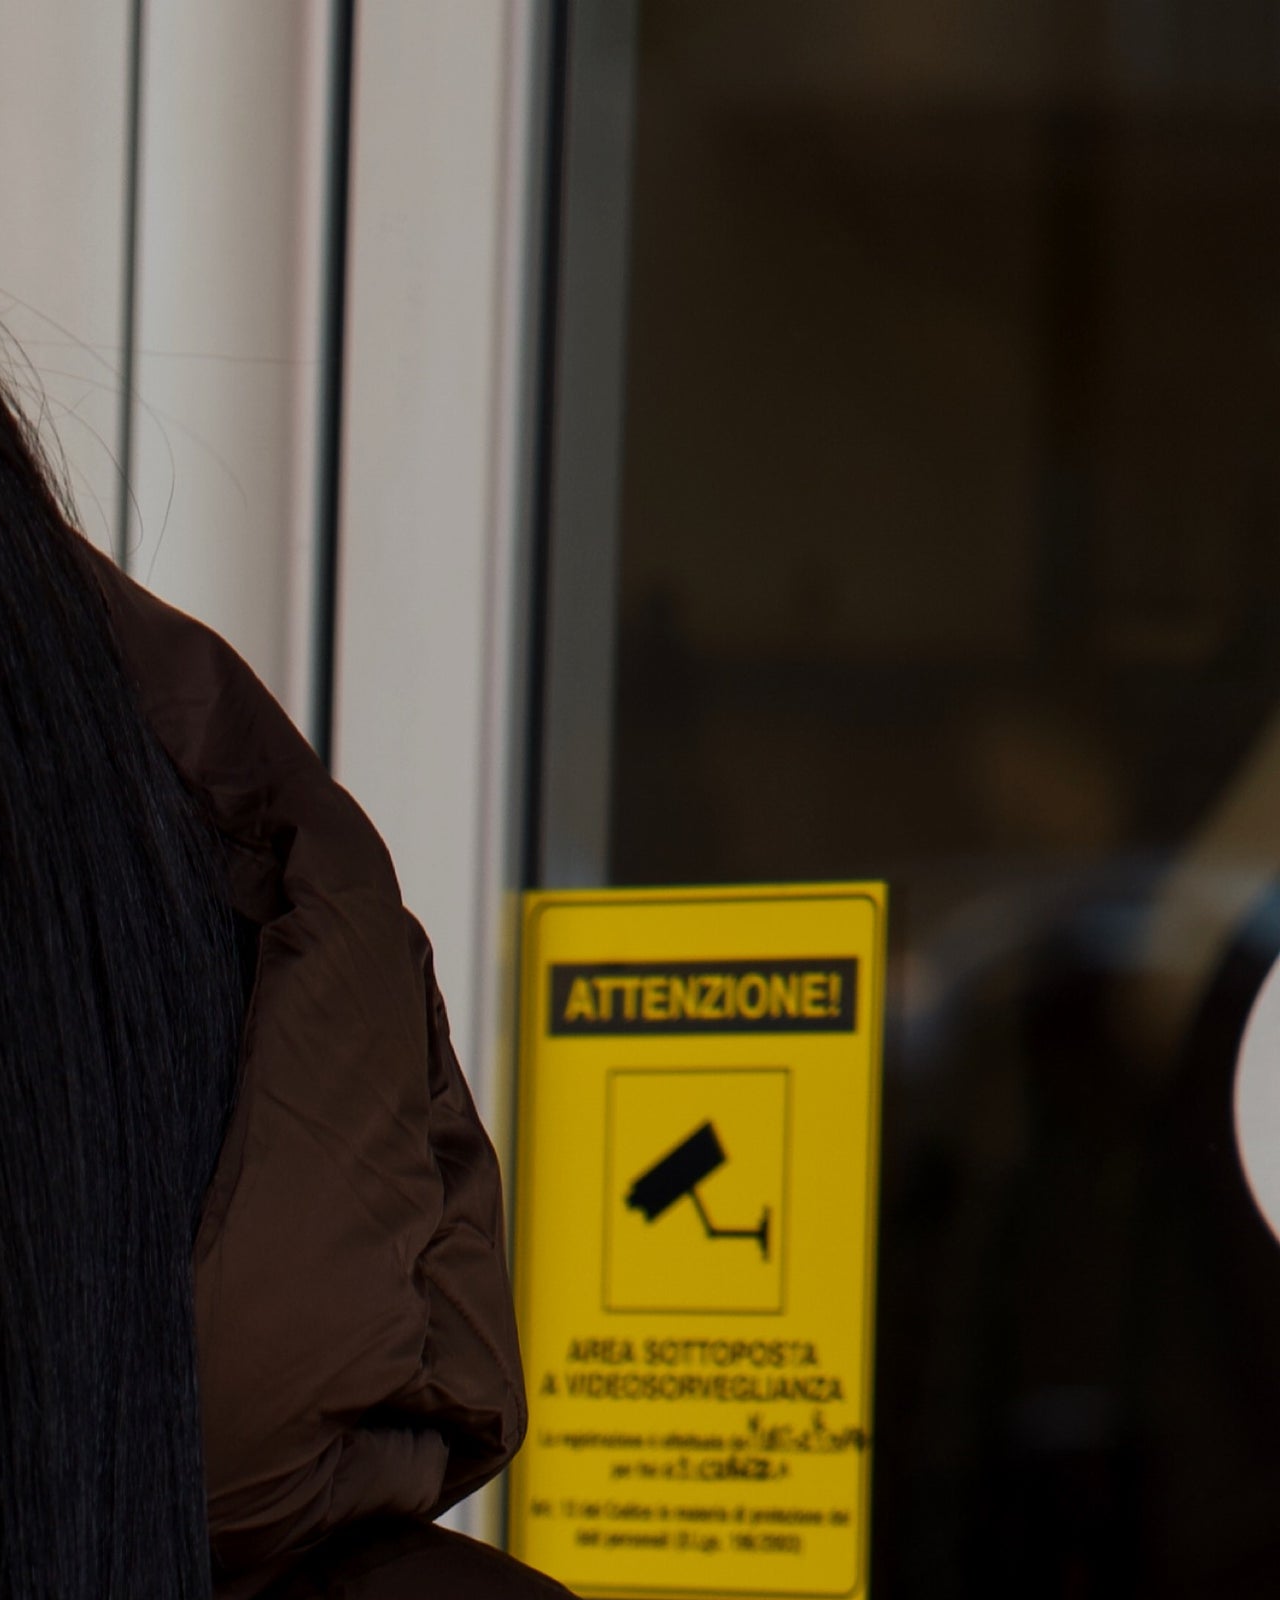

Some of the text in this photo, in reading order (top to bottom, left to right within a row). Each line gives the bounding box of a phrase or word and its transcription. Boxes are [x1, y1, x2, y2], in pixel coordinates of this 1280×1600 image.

[564, 973, 842, 1021] ATTENZIONE!
[567, 1338, 818, 1369] AREA SOTTOPOSTA
[541, 1373, 845, 1402] A VIDEOSORVEGLIANZA
